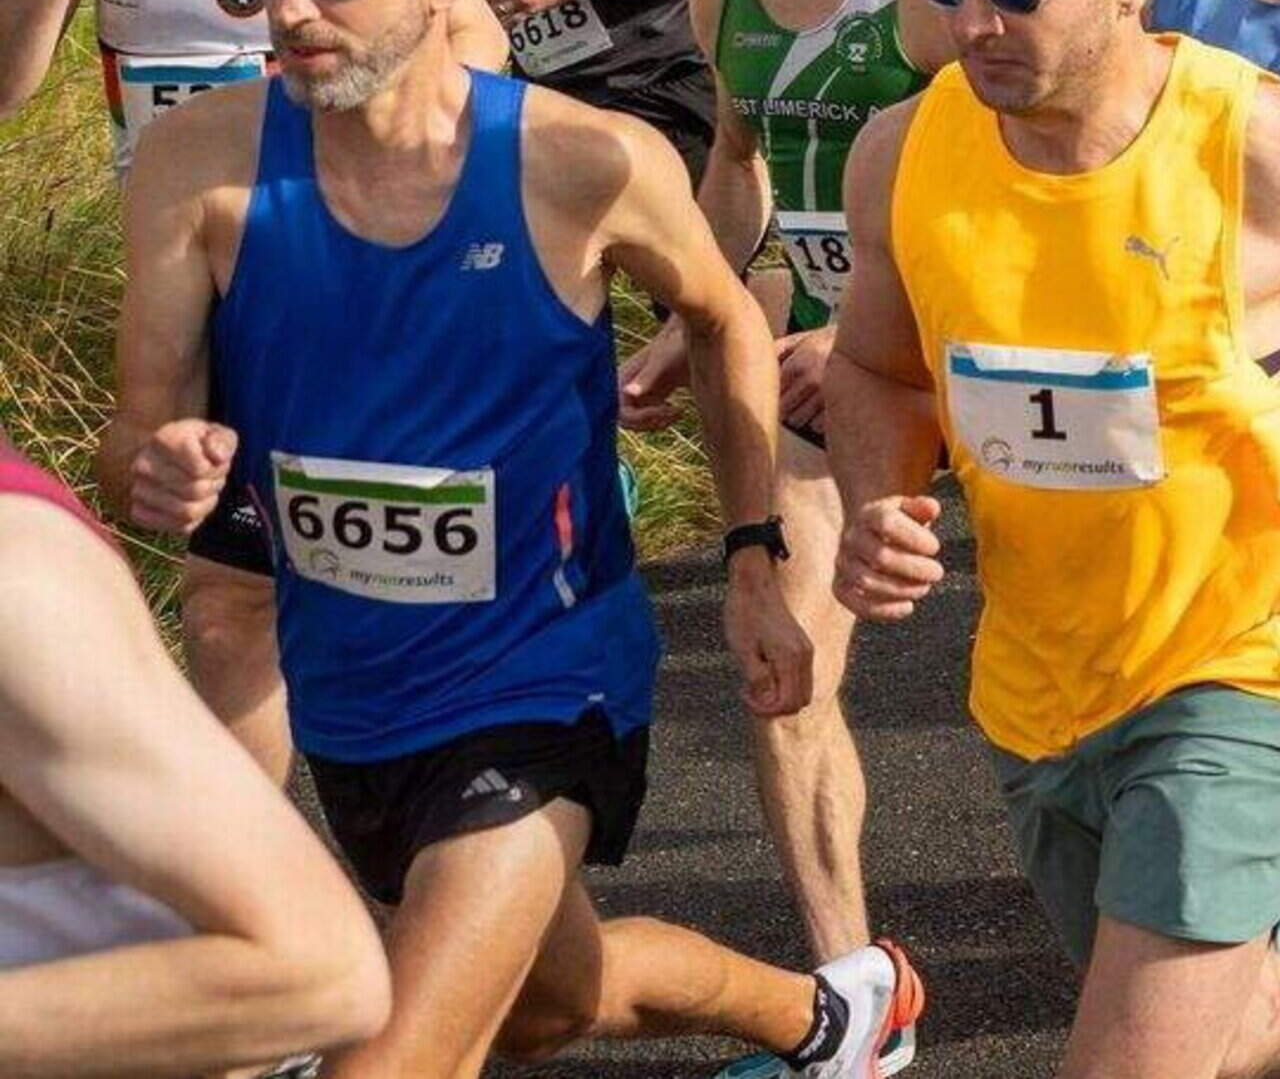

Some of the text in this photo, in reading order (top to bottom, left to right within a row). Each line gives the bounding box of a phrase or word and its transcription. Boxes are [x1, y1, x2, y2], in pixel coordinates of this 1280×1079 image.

[509, 0, 589, 53] 6618
[762, 99, 860, 121] LIMERICK
[795, 236, 852, 273] 18
[1029, 388, 1067, 442] 1
[1022, 459, 1125, 476] myrunresults
[287, 494, 478, 557] 6656
[349, 570, 456, 590] myrunresults
